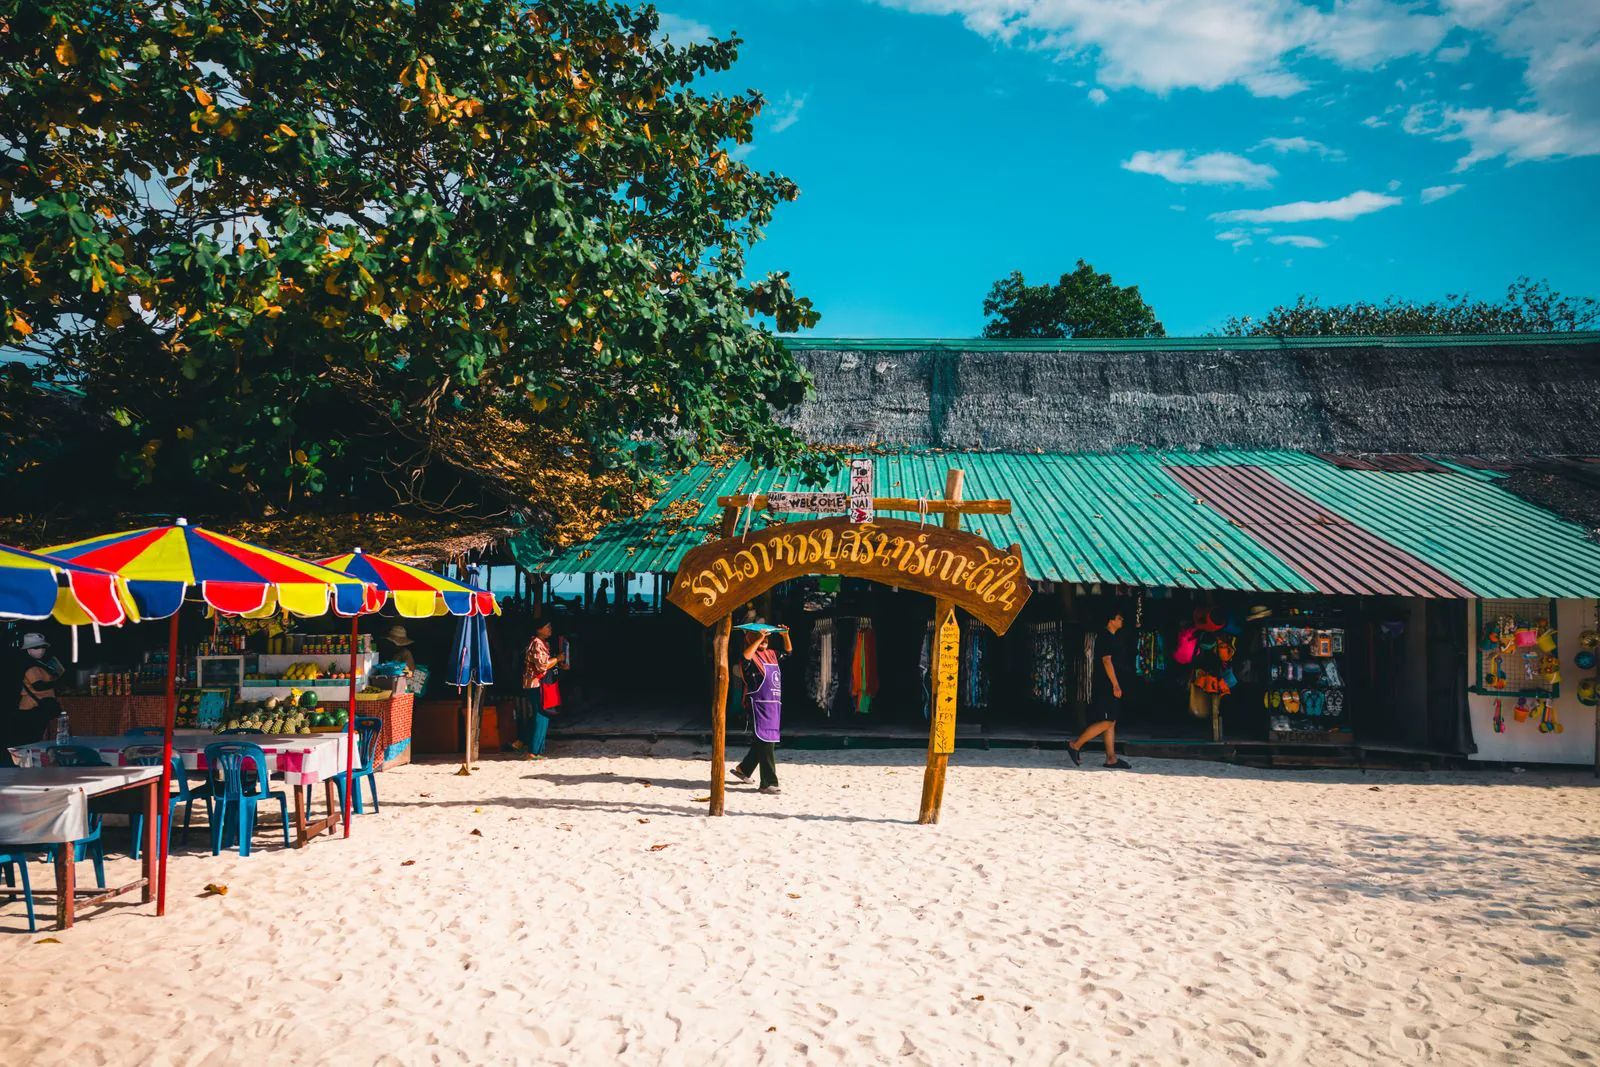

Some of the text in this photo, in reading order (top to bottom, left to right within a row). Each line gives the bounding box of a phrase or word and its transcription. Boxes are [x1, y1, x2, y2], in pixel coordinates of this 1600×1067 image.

[852, 482, 869, 495] KAI
[789, 496, 843, 508] WELCOME
[852, 499, 868, 508] NAI
